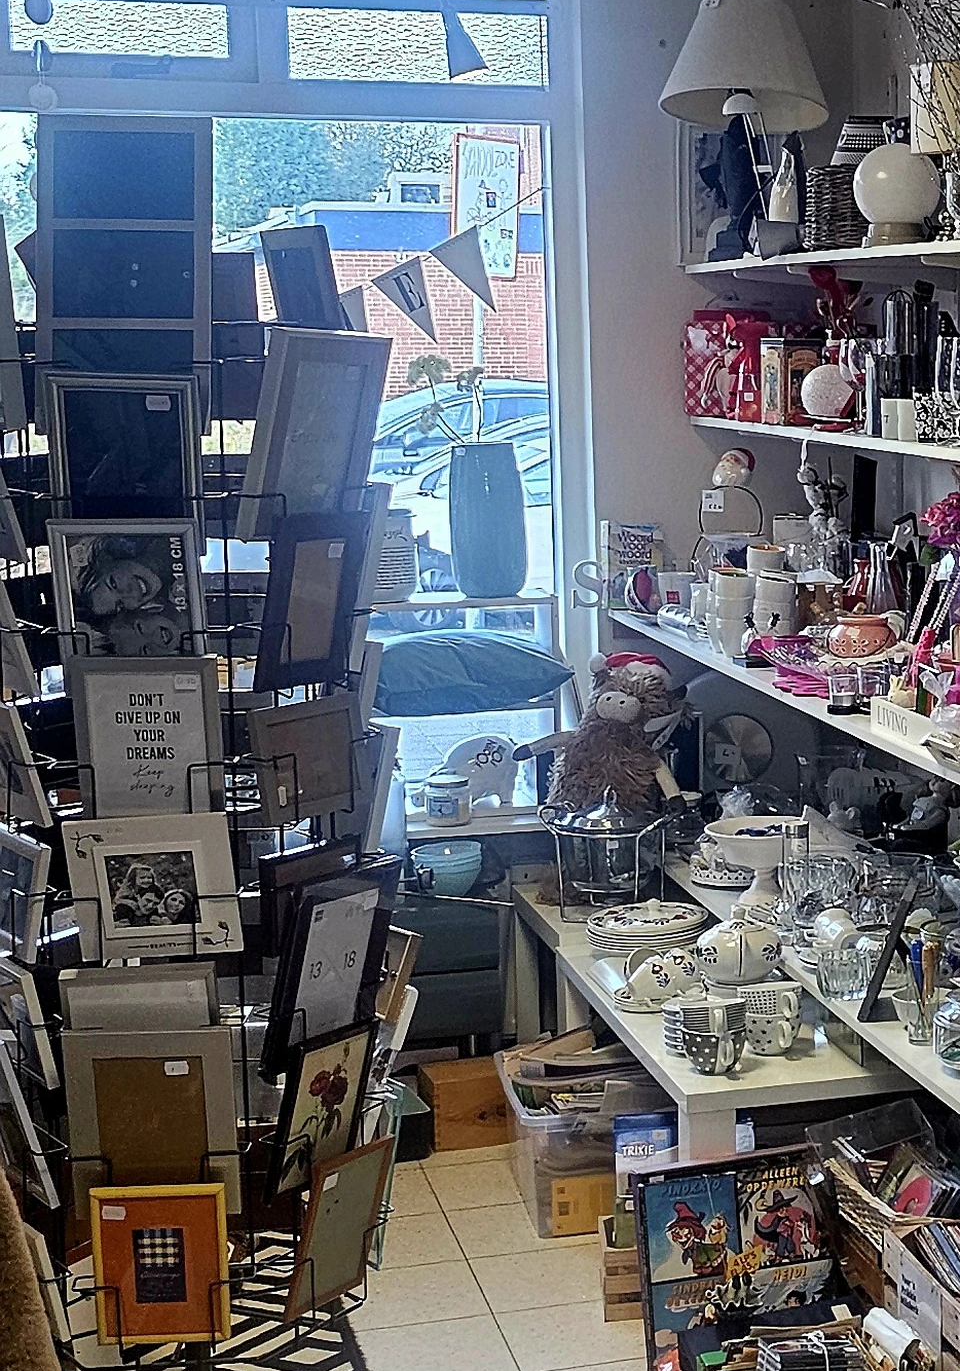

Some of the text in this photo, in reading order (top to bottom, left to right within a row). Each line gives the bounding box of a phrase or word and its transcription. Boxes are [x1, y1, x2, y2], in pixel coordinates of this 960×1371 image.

[392, 271, 426, 313] E
[129, 693, 165, 707] DON'T
[115, 711, 181, 725] GIVE UP ON
[877, 705, 908, 736] LIVING
[134, 729, 165, 742] YOUR
[126, 746, 176, 760] DREAMS
[309, 950, 357, 980] 13 18
[622, 1144, 655, 1157] TRIXIE
[762, 1166, 799, 1179] ALLEEN
[773, 1266, 808, 1282] HEIDI
